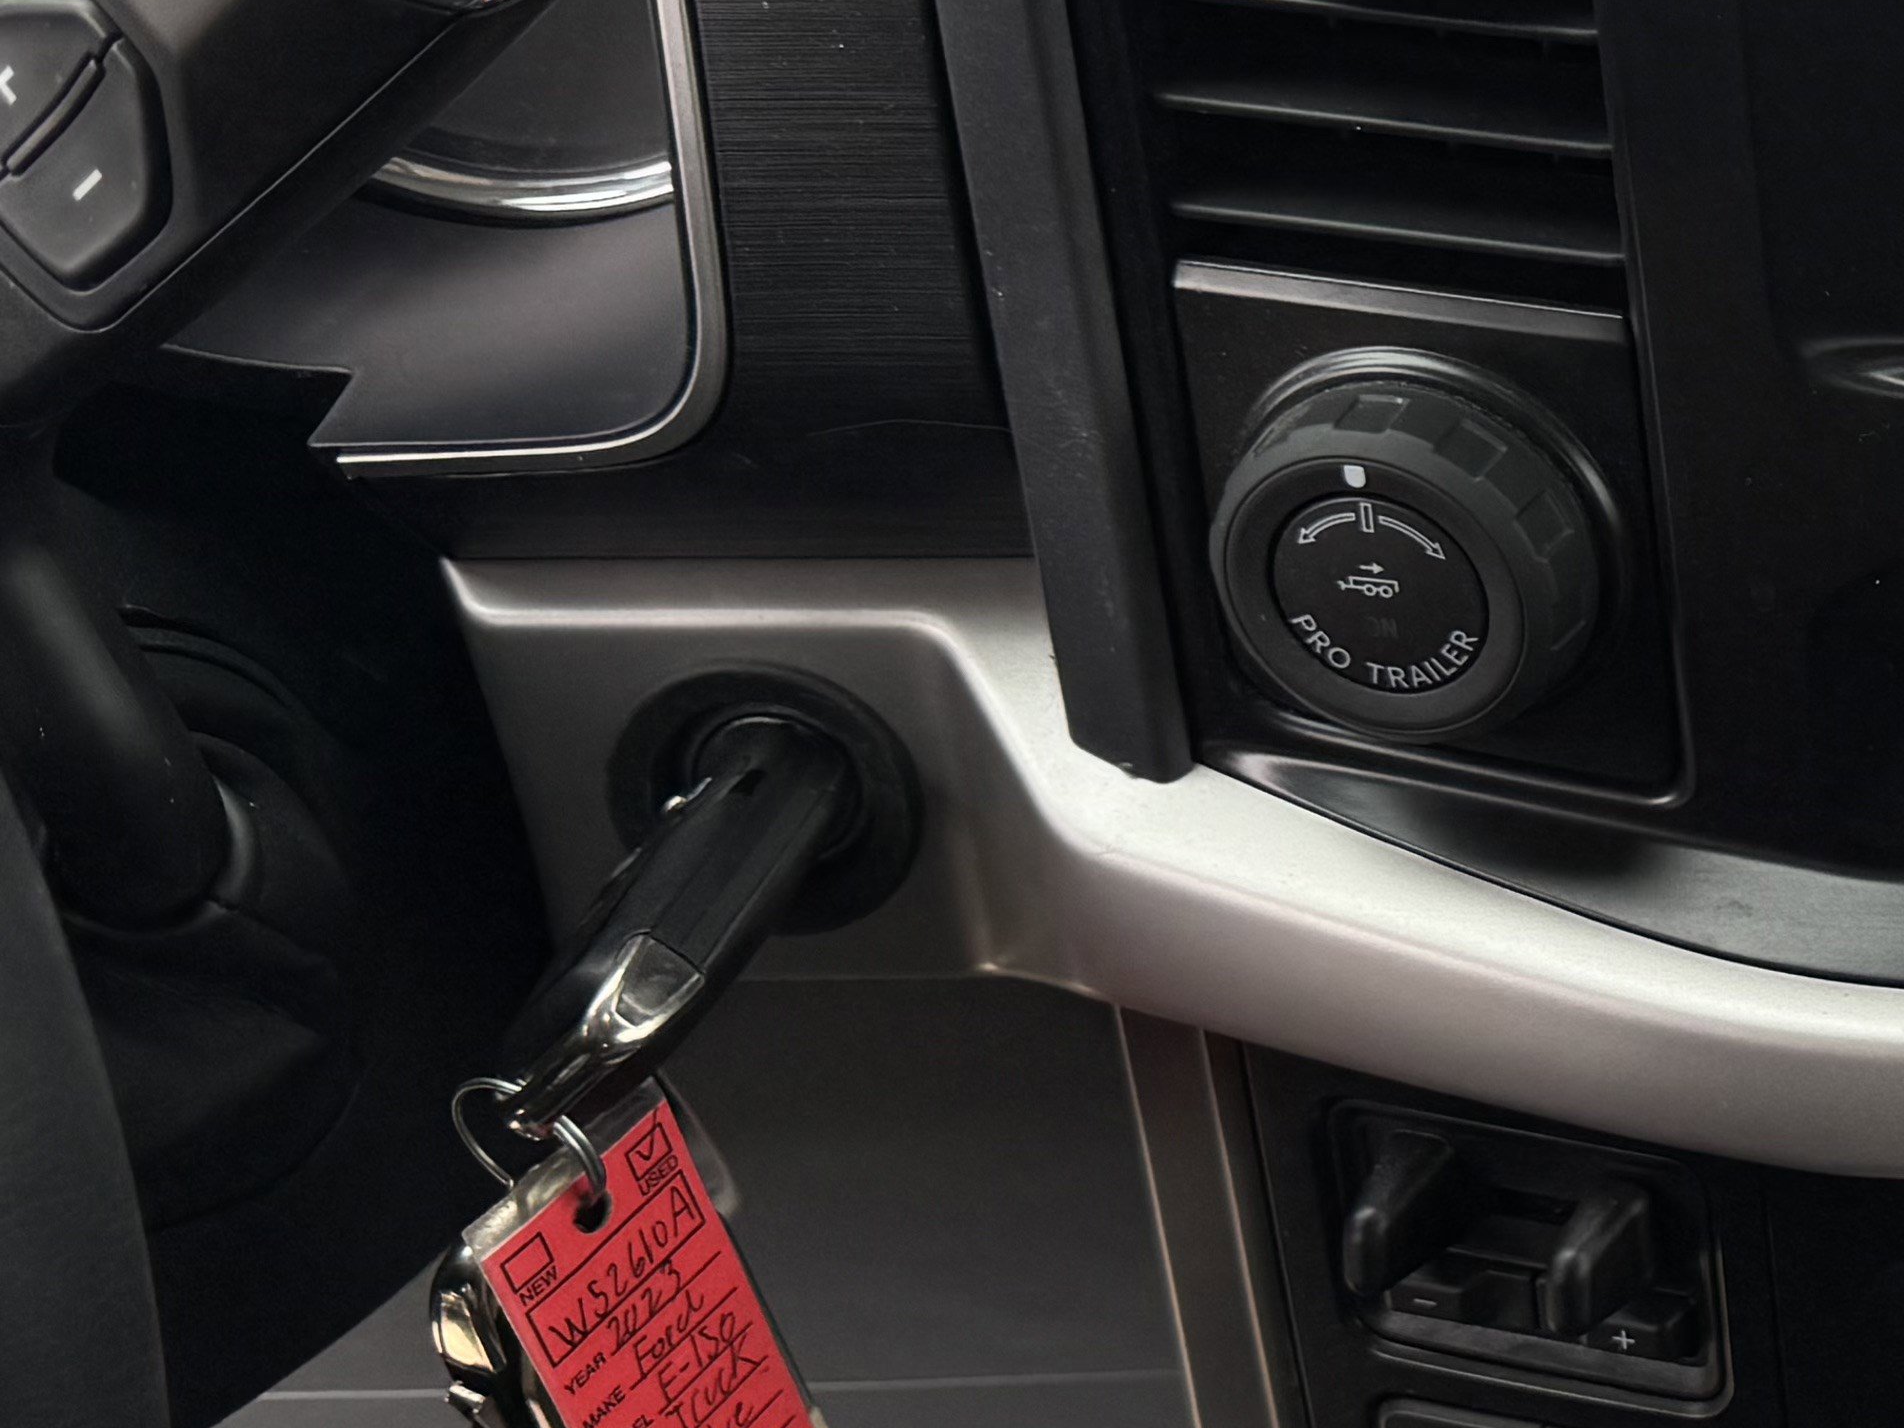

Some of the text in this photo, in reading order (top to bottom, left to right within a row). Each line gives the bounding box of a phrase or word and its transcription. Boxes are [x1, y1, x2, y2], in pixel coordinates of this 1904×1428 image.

[1291, 614, 1352, 669] PRO
[1366, 629, 1479, 690] TRAILER
[638, 1154, 679, 1197] USED
[519, 1265, 559, 1307] NEW
[632, 1289, 705, 1379] Ford
[564, 1351, 607, 1396] YEAR
